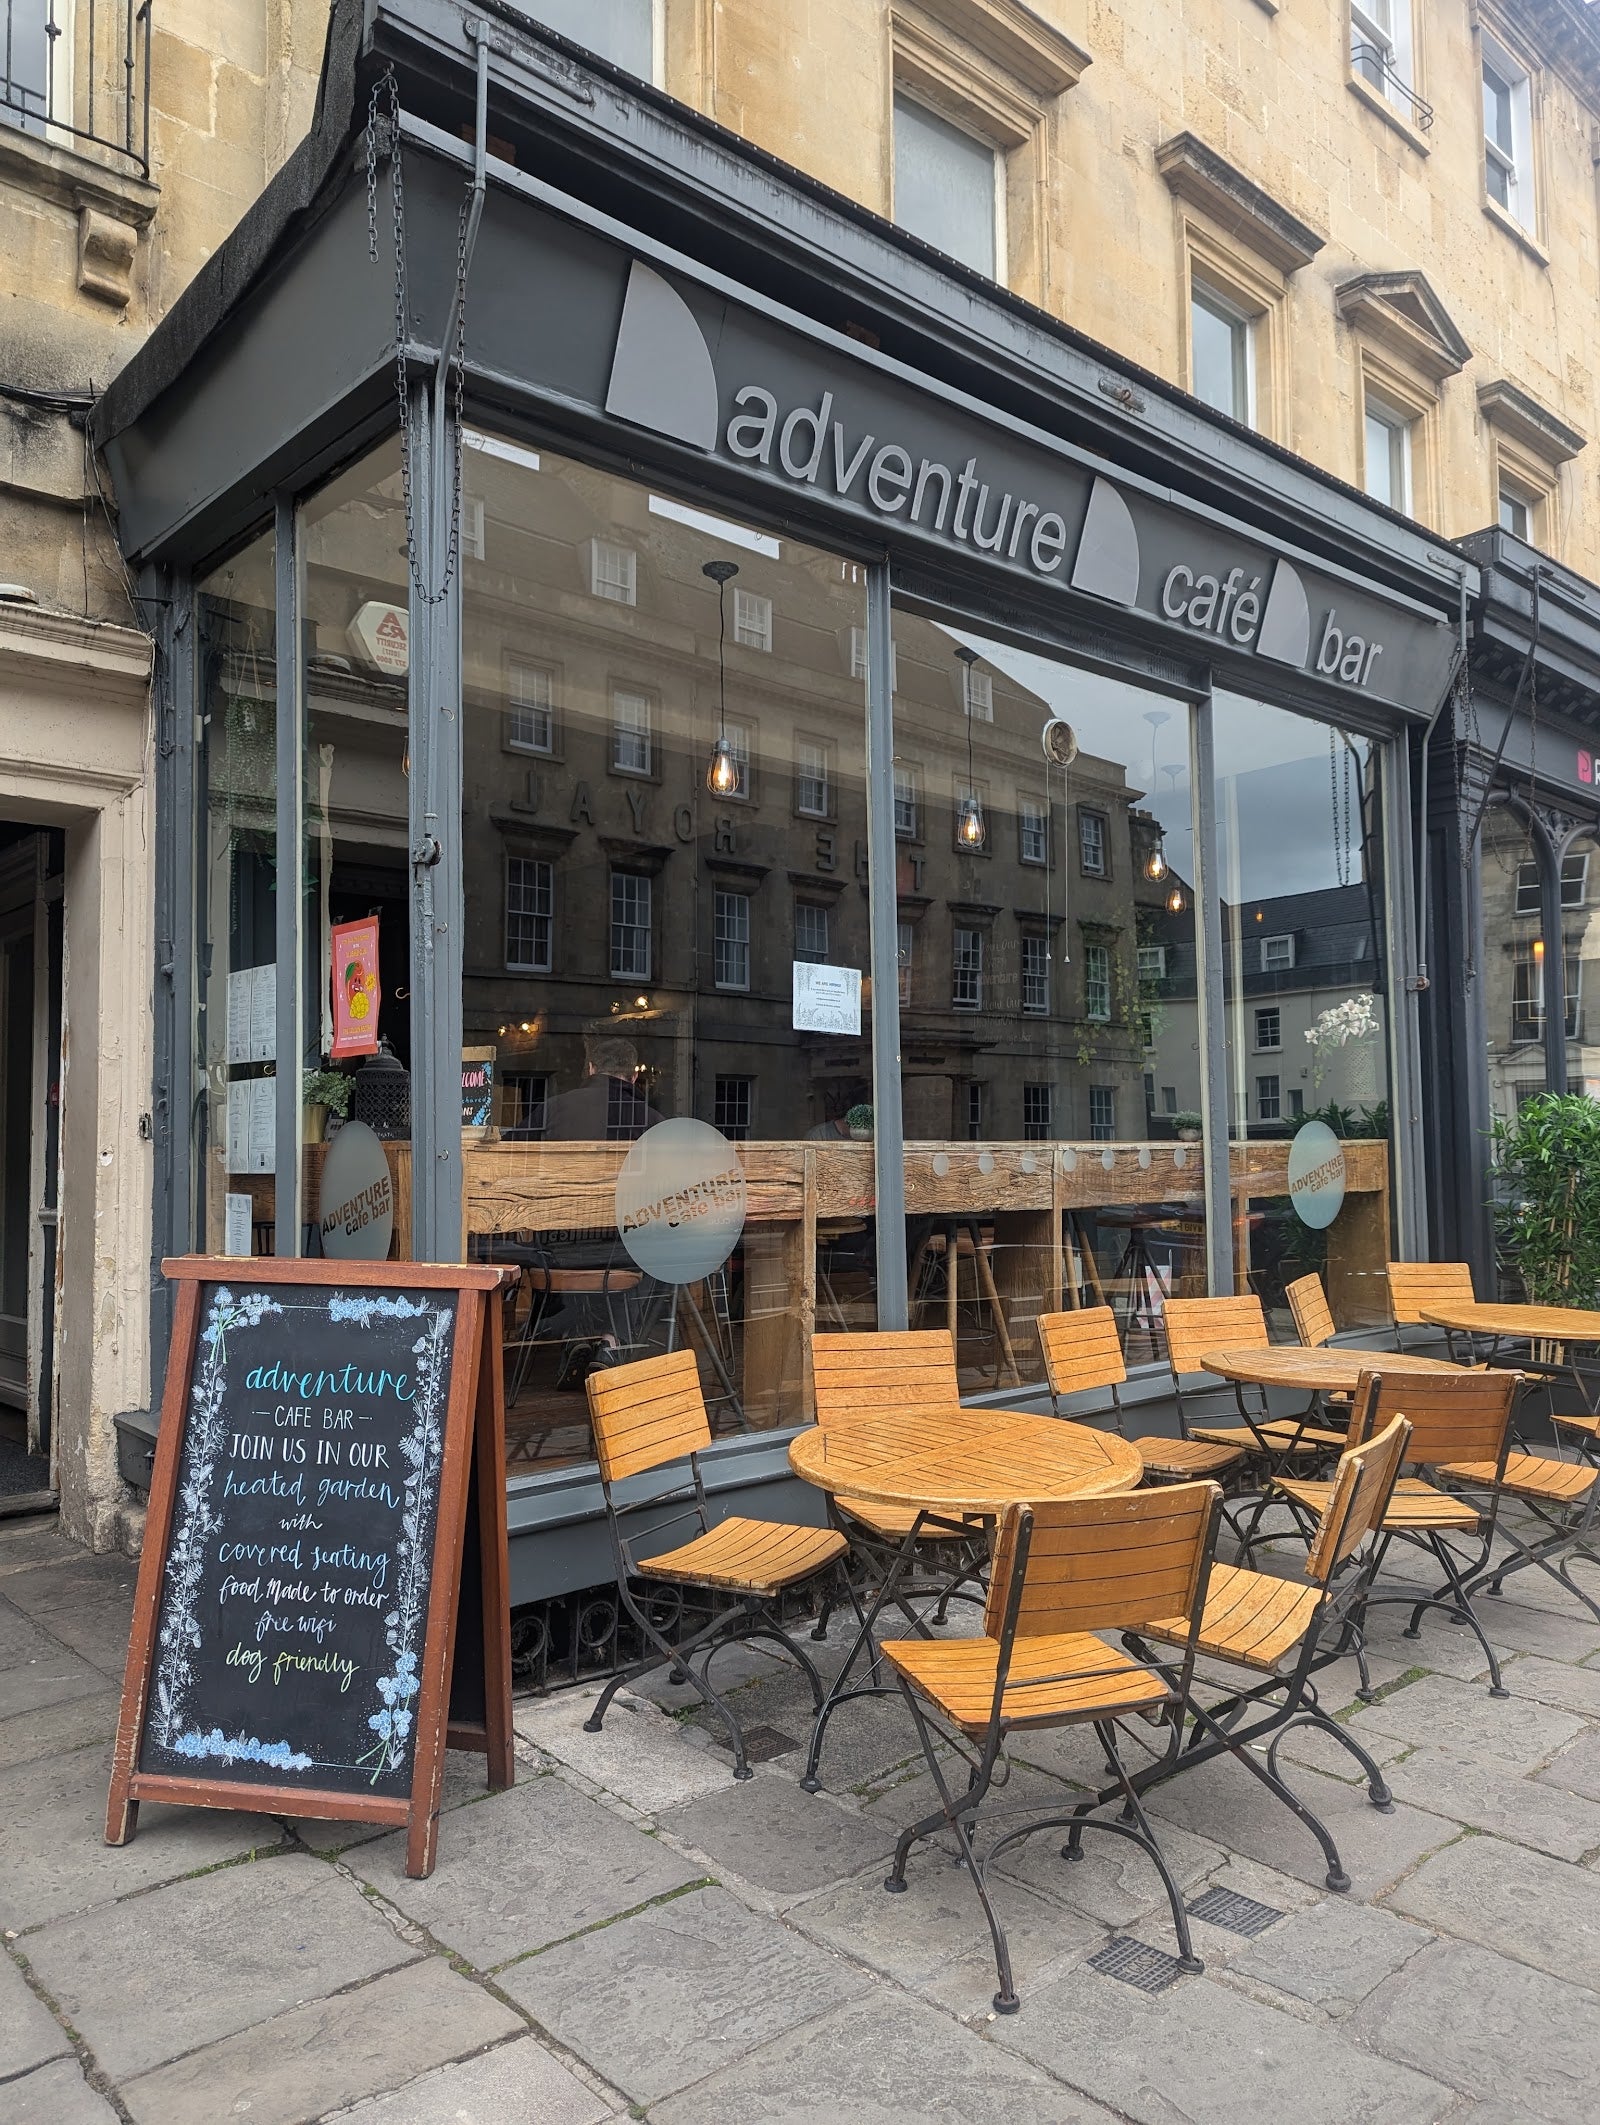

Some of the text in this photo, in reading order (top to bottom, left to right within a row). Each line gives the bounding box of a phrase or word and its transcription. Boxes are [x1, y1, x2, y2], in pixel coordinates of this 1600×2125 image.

[726, 385, 1384, 686] adventure café bar
[462, 1070, 486, 1088] LCOME
[1291, 1154, 1344, 1194] ADVENTURE
[322, 1175, 390, 1237] ADVENTURE
[345, 1196, 391, 1236] cafe bar
[623, 1168, 742, 1234] ADVENTURE
[246, 1360, 416, 1401] adventure
[274, 1405, 354, 1430] CAFE BAR
[229, 1433, 390, 1469] JOIN US IN OUR
[223, 1470, 400, 1509] heated garden
[278, 1513, 324, 1531] with
[219, 1540, 391, 1589] covered seating
[219, 1574, 264, 1605] food
[320, 1581, 343, 1604] to
[344, 1588, 390, 1609] order
[255, 1610, 338, 1644] free wifi
[226, 1641, 360, 1693] dog friendly
